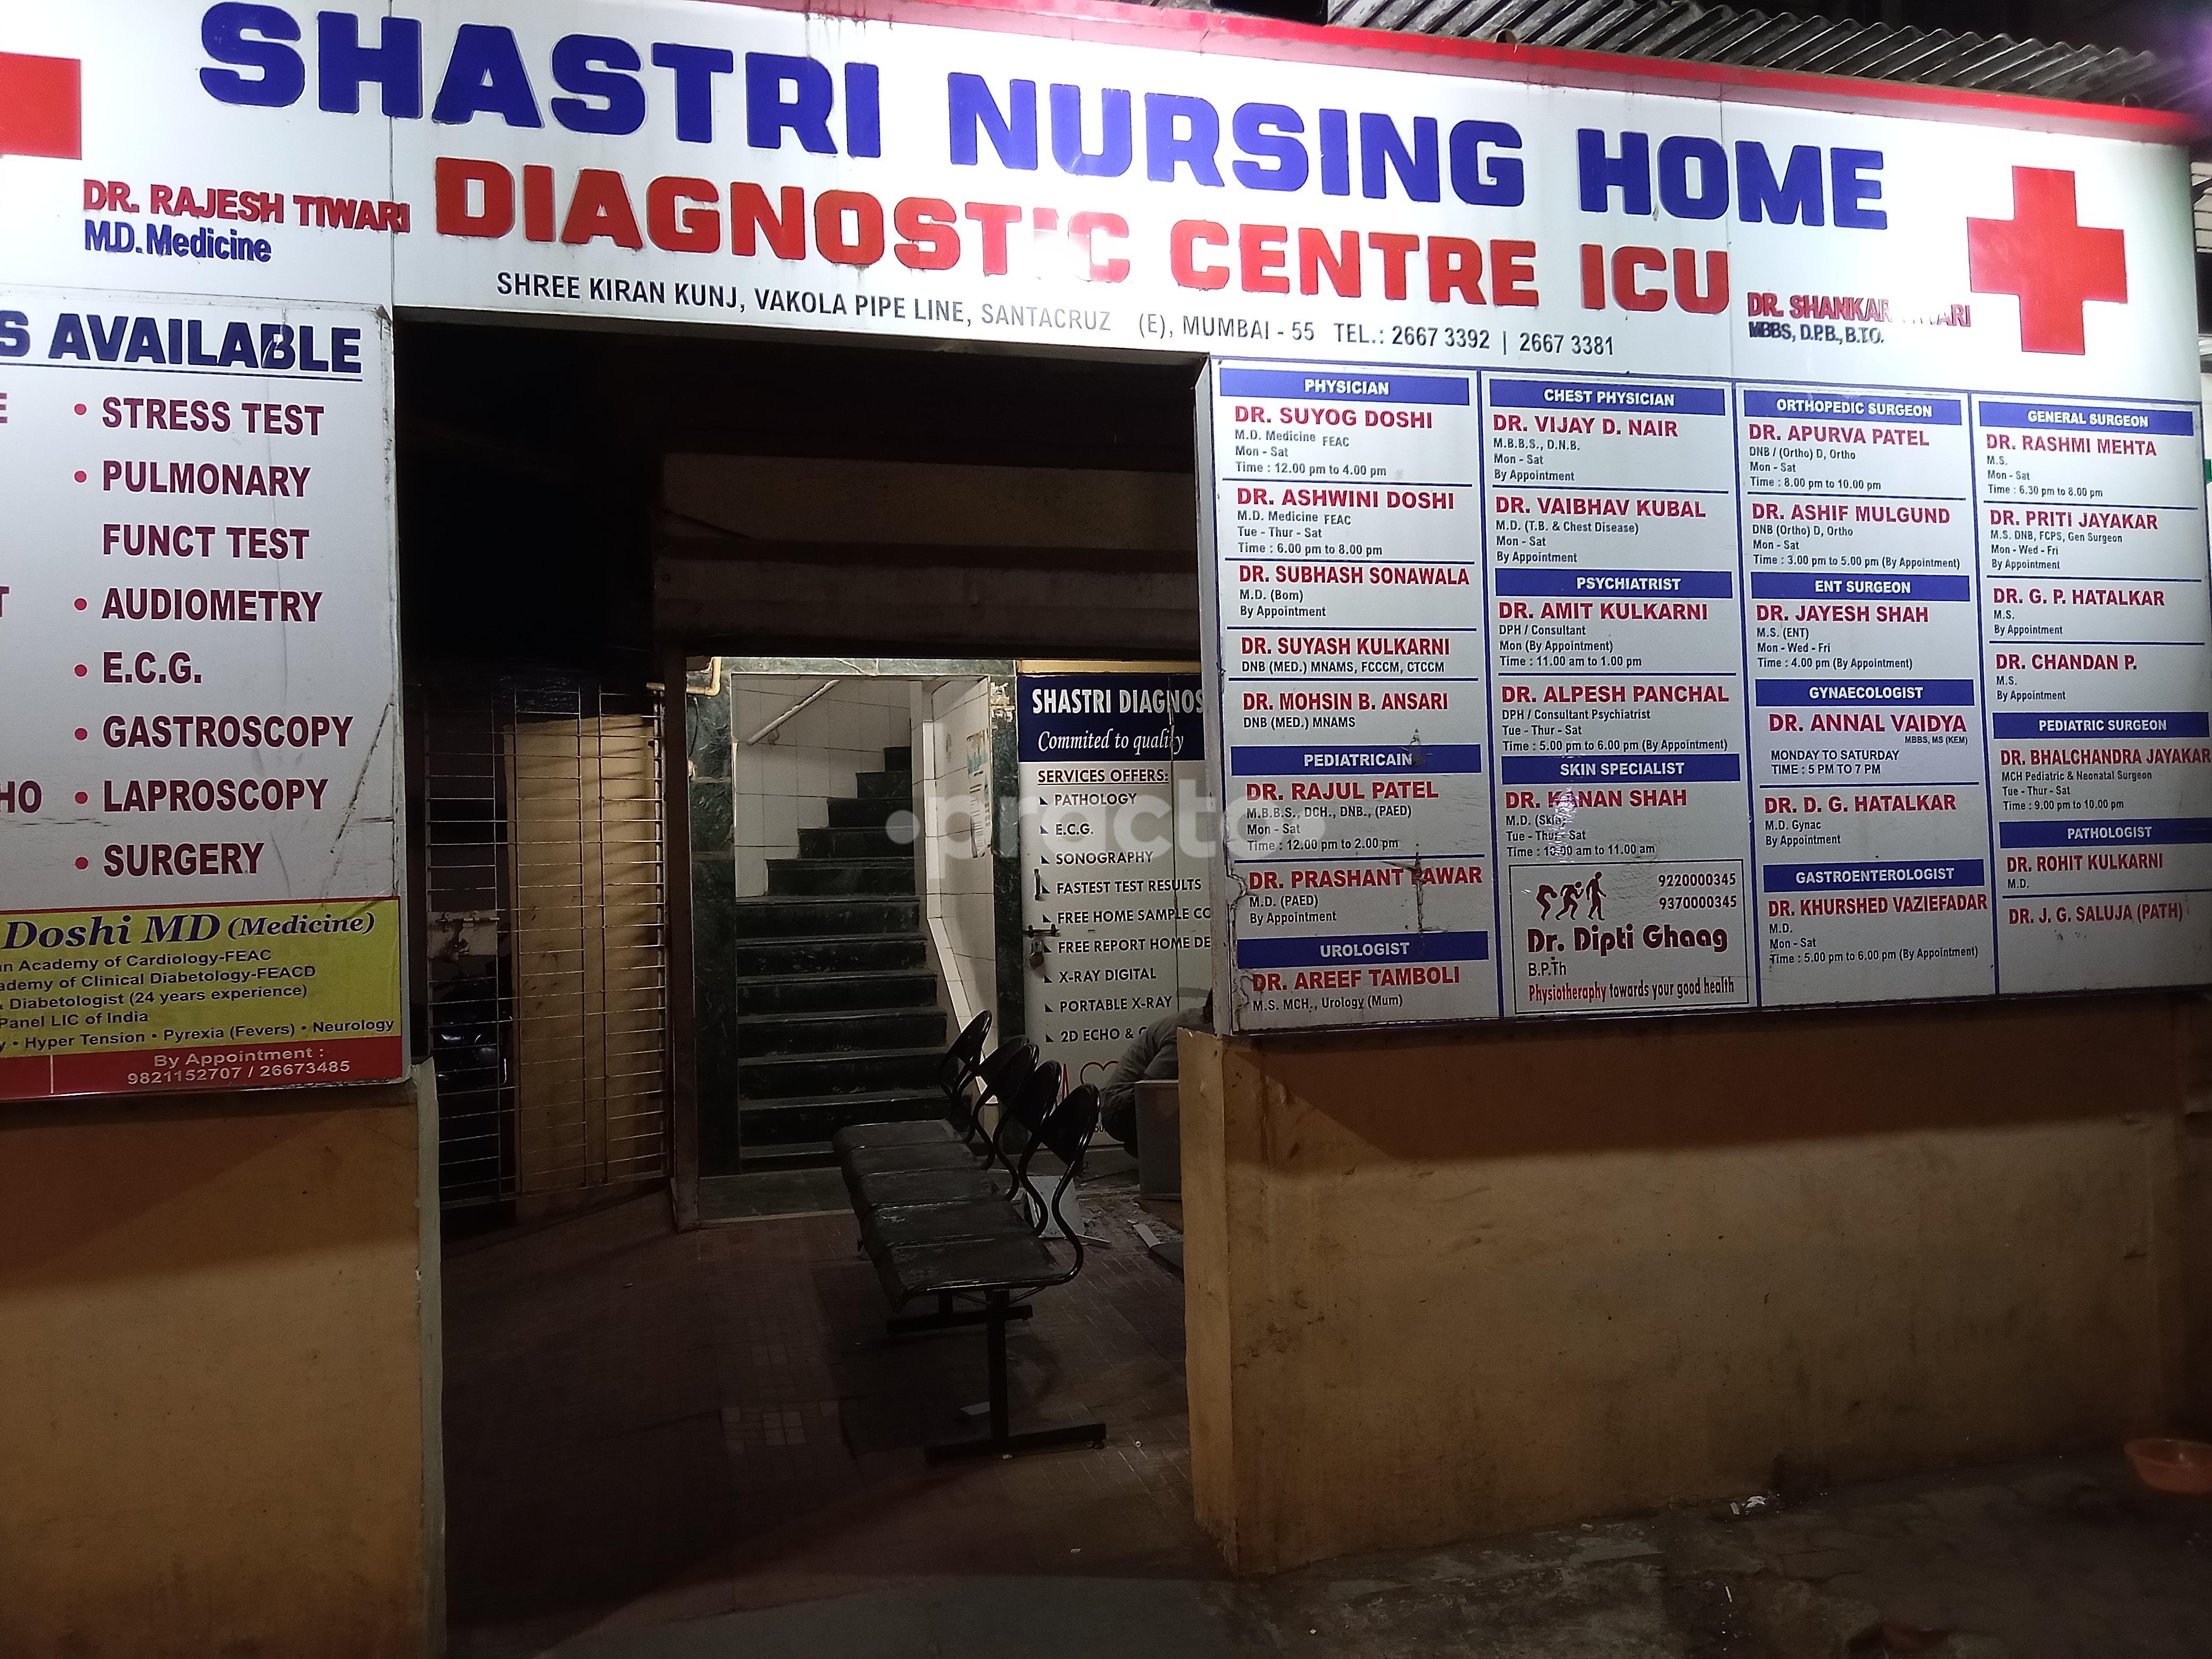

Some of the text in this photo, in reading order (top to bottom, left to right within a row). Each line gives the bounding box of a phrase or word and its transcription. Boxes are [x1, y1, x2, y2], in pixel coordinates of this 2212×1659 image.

[199, 1, 1888, 230] SHASTRI NURSING HOME
[83, 179, 410, 233] DR. RAJESH TIWARI
[146, 223, 272, 263] Medicine
[1169, 219, 1540, 308] CENTRE
[1580, 242, 1730, 315] ICU
[497, 272, 971, 327] SHREE KIRAN KUNJ, VAKOLA PIPE LINE,
[1747, 291, 1784, 317] DR.
[1789, 295, 1888, 322] SHANKAR
[981, 304, 1314, 341] SANTACRUZ (E), MUMBAI 55
[48, 313, 362, 373] AVAILABLE
[1392, 325, 1438, 347] 2667
[1444, 327, 1490, 349] 3392
[1519, 332, 1564, 354] 2667
[1571, 335, 1613, 355] 3381
[1304, 379, 1389, 395] PHYSICIAN
[1544, 389, 1674, 406] CHEST PHYSICIAN
[102, 397, 324, 436] STRESS TEST
[1777, 396, 1932, 417] ORTHOPEDIC SURGEON
[1235, 406, 1432, 429] DR. SUYOG DOSHI
[1493, 414, 1678, 437] DR. VIJAY D. NAIR
[2027, 410, 2148, 428] GENERAL SURGEON
[103, 460, 311, 497] PULMONARY
[1524, 520, 1548, 533] (T.B.
[1552, 521, 1561, 531] &
[1563, 521, 1592, 532] Chest
[1595, 522, 1639, 535] Disease)
[1990, 530, 2123, 544] M.S. DNB, FCPS, Gen Surgeon
[103, 523, 310, 559] FUNCT TEST
[1577, 577, 1681, 590] PSYCHIATRIST
[1815, 580, 1911, 593] ENT SURGEON
[101, 588, 323, 622] AUDIOMETRY
[103, 651, 202, 684] E.C.G.
[1242, 661, 1444, 675] DNB (MED.) MNAMS, FCCCM, CTCCM
[1032, 689, 1111, 714] SHASTRI
[1809, 686, 1923, 699] GYNAECOLOGIST
[103, 715, 354, 748] GASTROSCOPY
[2039, 719, 2167, 731] PEDIATRIC SURGEON
[1038, 728, 1113, 752] Commited
[1115, 733, 1129, 749] to
[1945, 736, 1968, 745] (KEM)
[1304, 753, 1412, 767] PEDIATRICAIN
[1560, 762, 1685, 776] SKIN SPECIALIST
[1038, 768, 1170, 783] SERVICES OFFERS:
[104, 778, 329, 812] LAPROSCOPY
[1054, 792, 1137, 806] PATHOLOGY
[1055, 823, 1094, 835] E.C.G.
[2067, 826, 2152, 840] PATHOLOGIST
[103, 842, 265, 877] SURGERY
[1055, 851, 1153, 865] SONOGRAPHY
[2007, 852, 2163, 873] DR. ROHIT KULKARNI
[1057, 878, 1202, 894] FASTEST TEST RESULTS
[1658, 873, 1736, 887] 9220000345
[1796, 867, 1955, 884] GASTROENTEROLOGIST
[1659, 895, 1737, 910] 9370000345
[1768, 893, 1988, 917] DR. KHURSHED VAZIEFADAR
[1058, 911, 1089, 924] FREE
[1093, 909, 1134, 923] HOME
[1137, 908, 1189, 921] SAMPLE
[1, 912, 375, 950] Doshi MD (Medicine)
[1527, 923, 1728, 957] Dr. Dipti Ghaag
[1058, 941, 1090, 954] FREE
[1094, 938, 1146, 952] REPORT
[1150, 934, 1190, 952] HOME
[1320, 942, 1410, 958] UROLOGIST
[18, 949, 272, 971] Academy of Cardiology-FEAC
[1059, 967, 1157, 984] X-RAY DIGITAL
[10, 984, 307, 1010] Diabetologist (24 years experience)
[1529, 975, 1736, 1006] Physiotheraphy towards your good health
[1060, 995, 1172, 1013] PORTABLE X-RAY
[1253, 997, 1279, 1011] M.S.
[1321, 996, 1364, 1013] Urology
[1367, 993, 1403, 1009] (Mum)
[25, 1019, 395, 1051] Hyper Tension Pyrexia (Fevers) Neurology
[1060, 1027, 1134, 1043] 2D ECHO &
[154, 1047, 314, 1069] By Appointment
[128, 1060, 350, 1085] 9821152707 26673485
